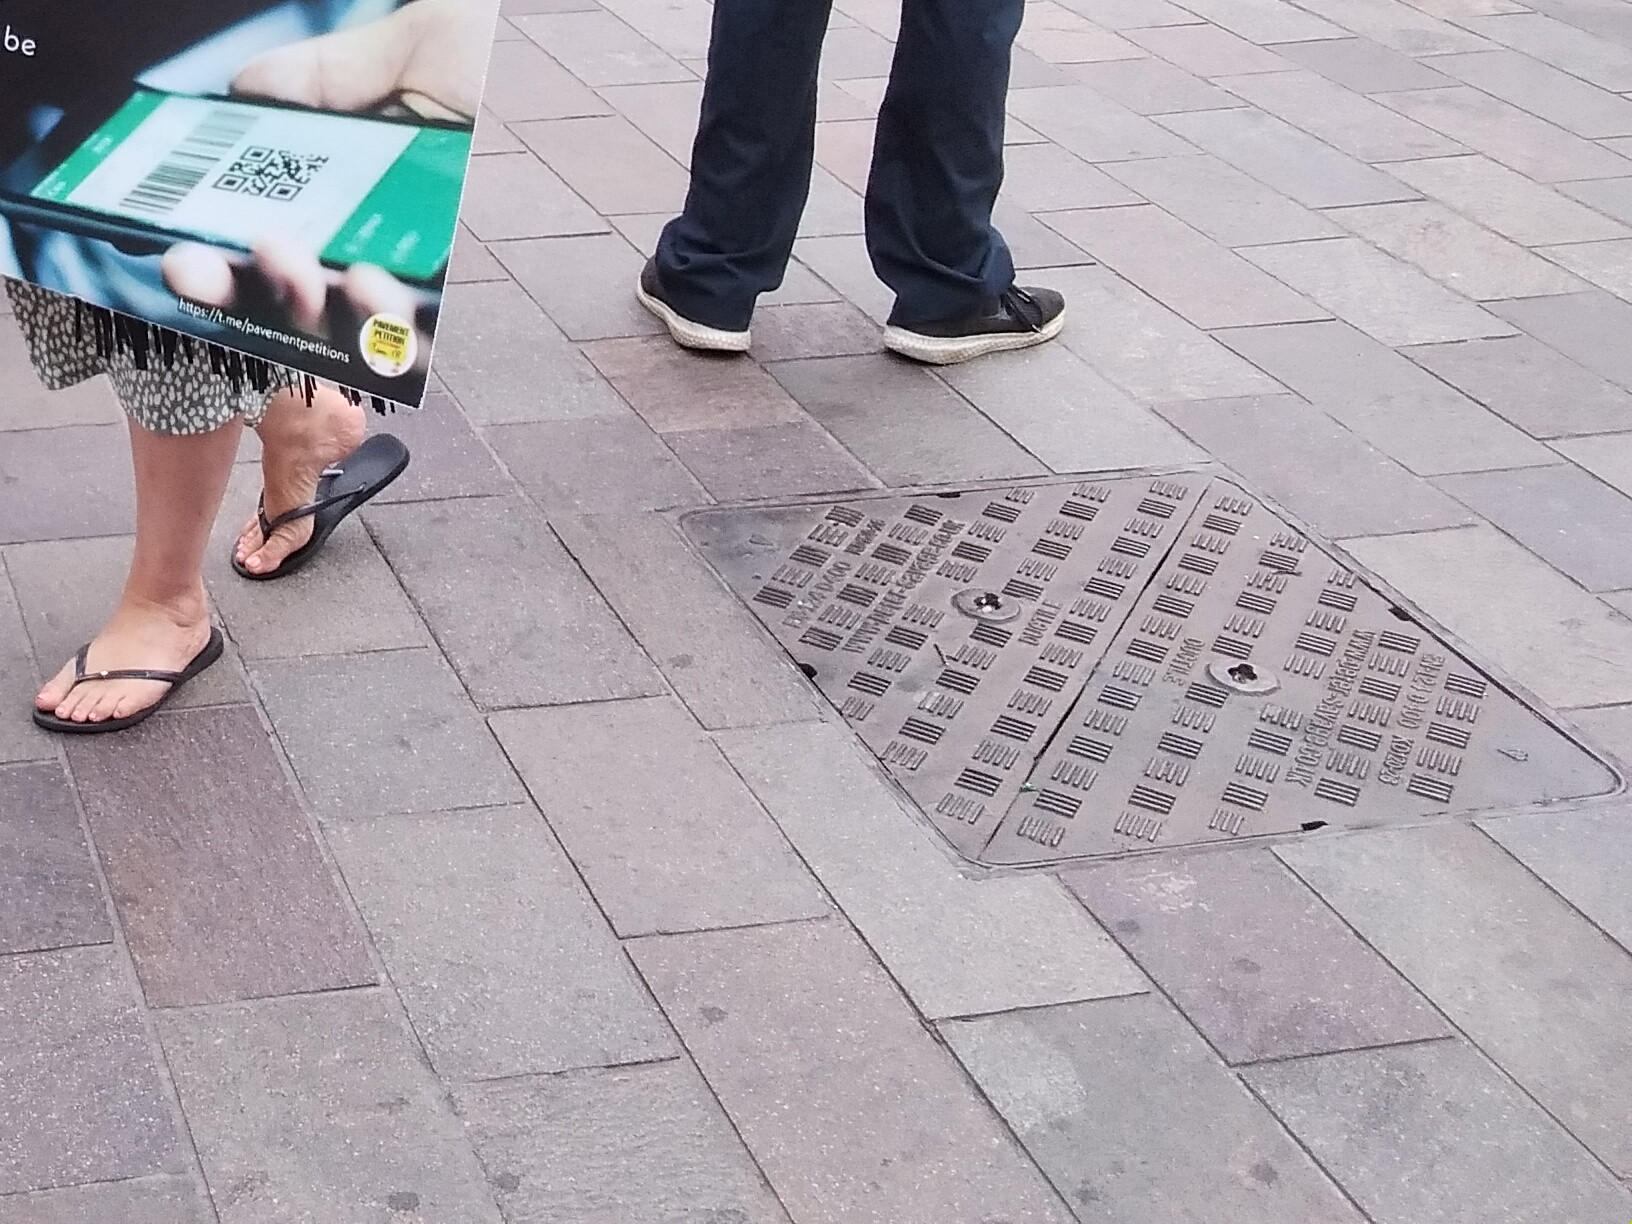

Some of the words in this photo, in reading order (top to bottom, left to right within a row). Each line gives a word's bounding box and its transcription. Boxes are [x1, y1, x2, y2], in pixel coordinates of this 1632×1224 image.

[4, 25, 37, 56] be
[178, 297, 351, 364] https://t.me/pavementpetitions
[1018, 600, 1064, 646] DUCTILE
[1163, 637, 1205, 686] DUCTILE
